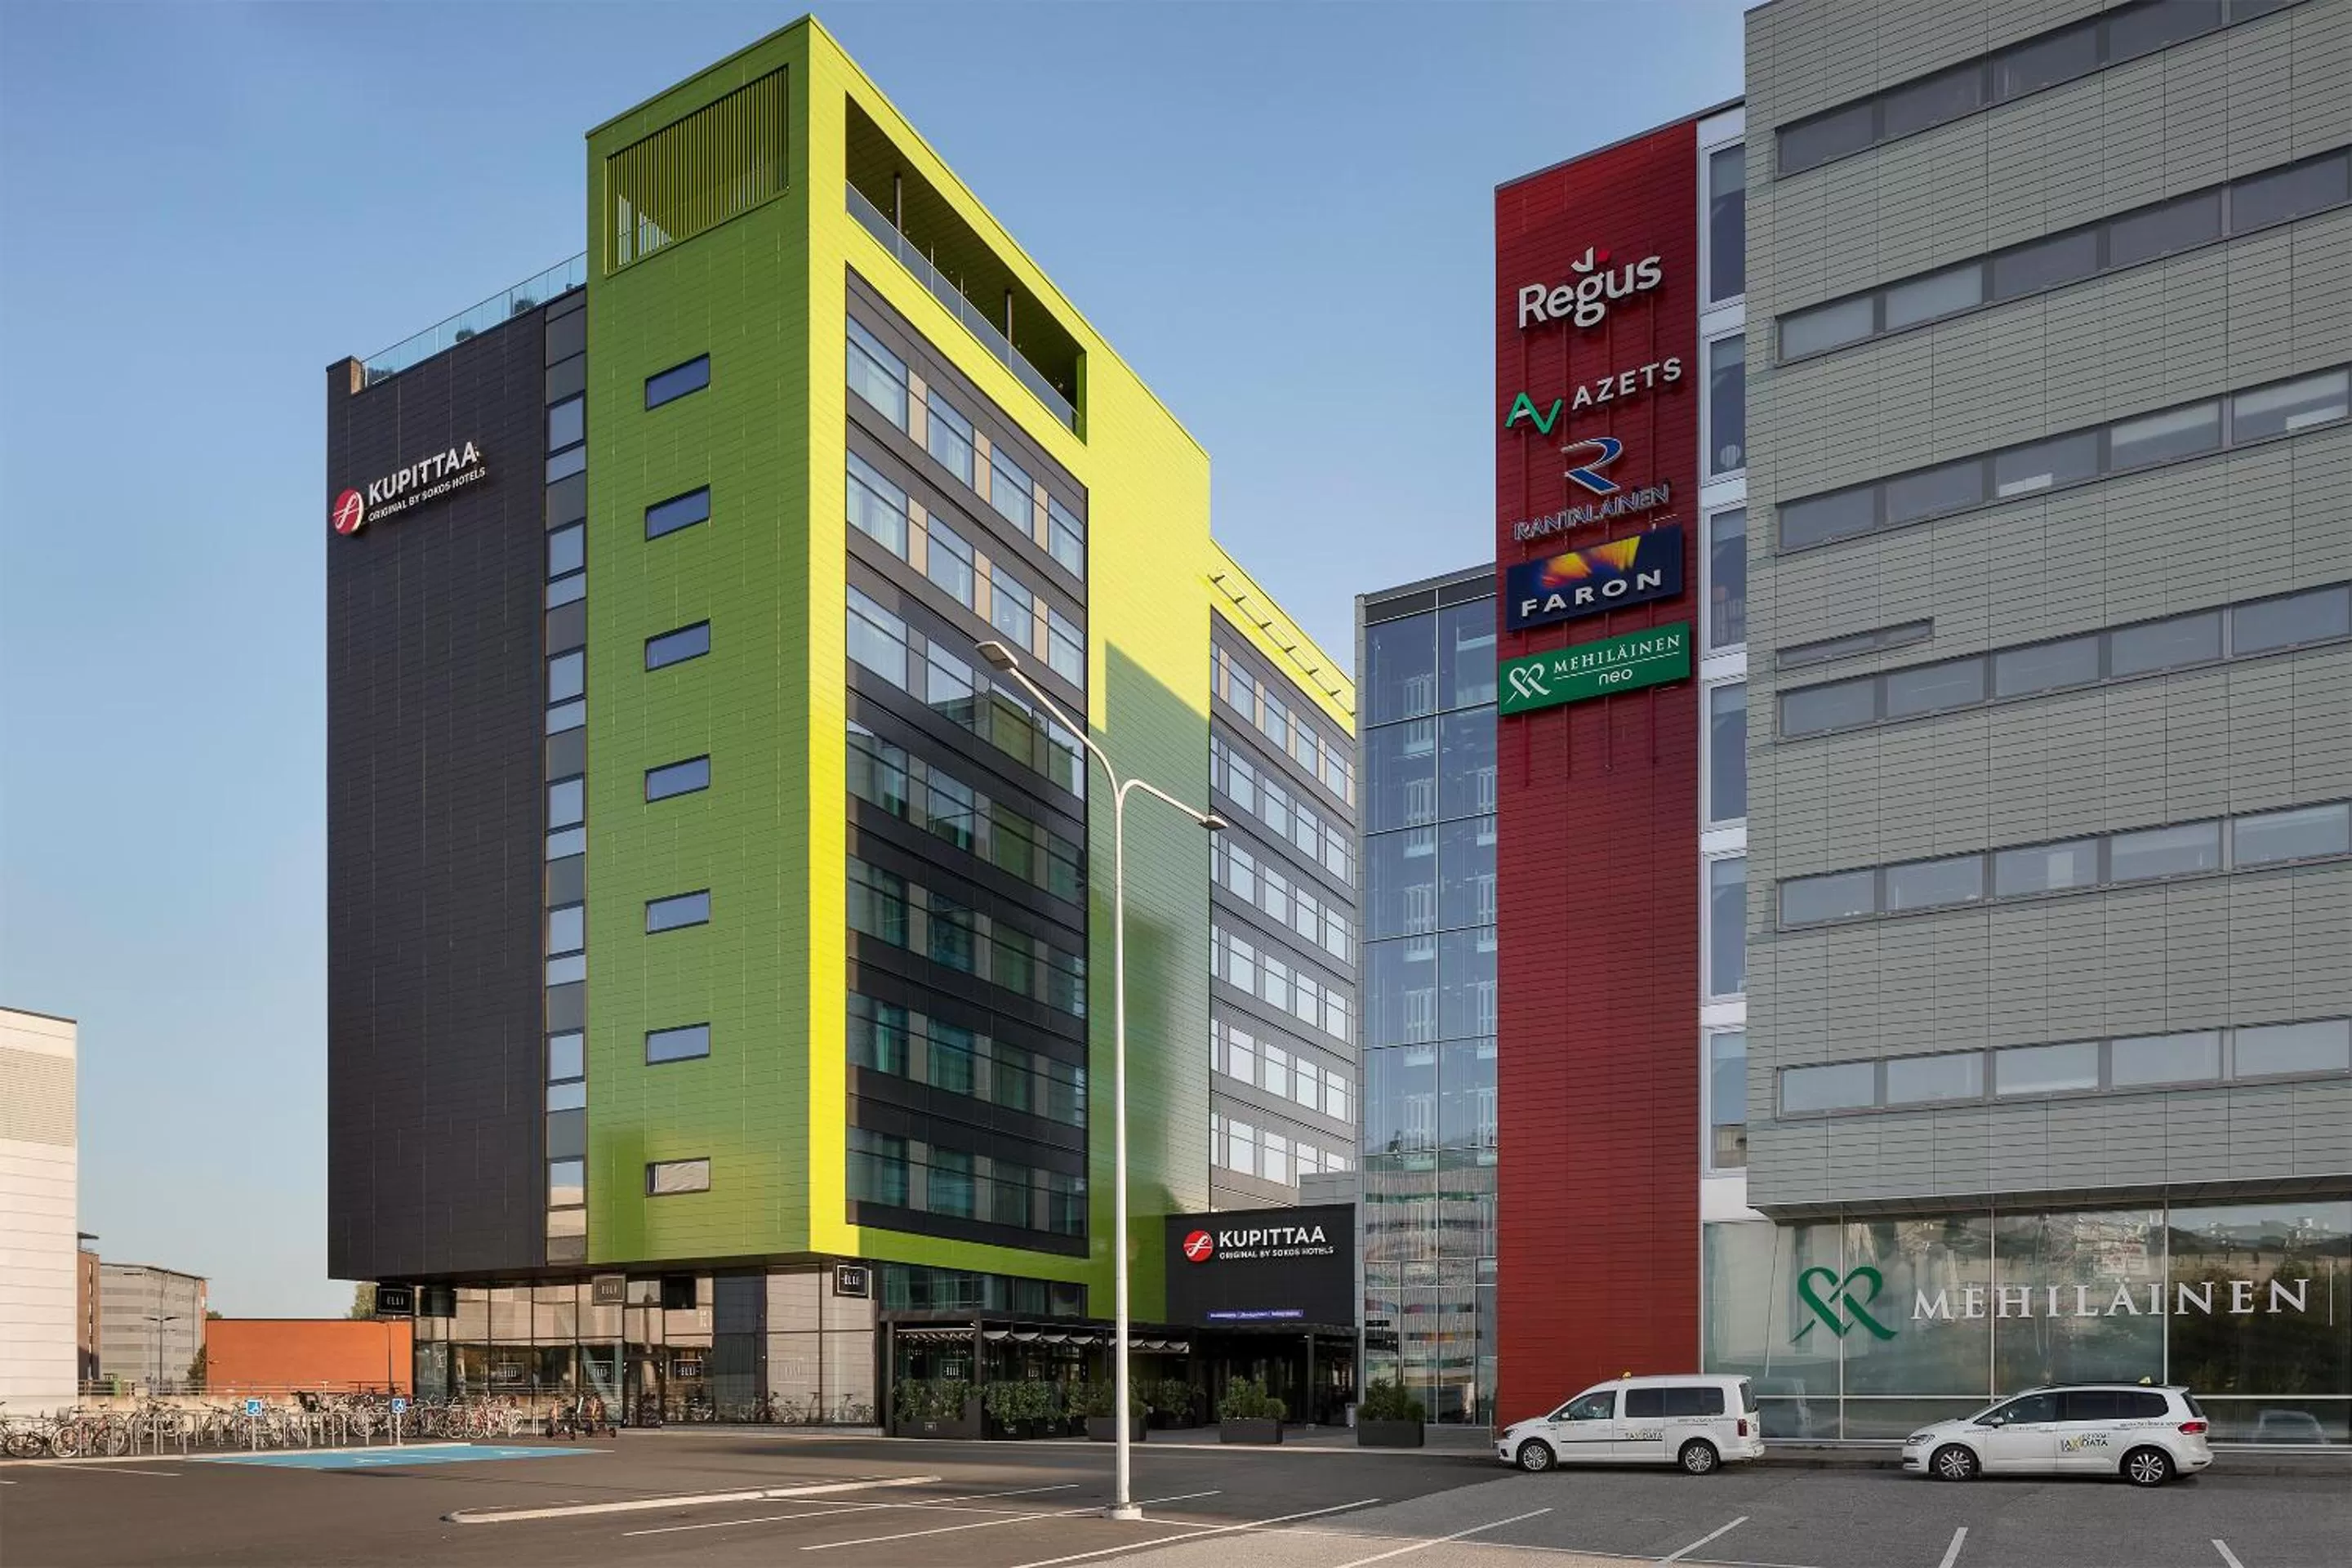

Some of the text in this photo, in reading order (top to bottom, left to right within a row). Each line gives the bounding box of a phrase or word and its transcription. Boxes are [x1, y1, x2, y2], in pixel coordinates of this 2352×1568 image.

[1518, 248, 1663, 329] Regus
[1572, 357, 1682, 410] AZETS
[368, 441, 478, 506] KUPITTAA
[368, 466, 486, 522] ORIGINAL BY SOKOS HOTELS
[1514, 483, 1670, 540] RANTALAINEN
[1521, 569, 1662, 617] FARON
[1553, 635, 1681, 674] MEHILÄINEN
[1598, 668, 1633, 686] neo
[1219, 1226, 1325, 1247] KUPITTAA
[1219, 1246, 1334, 1259] ORIGINAL BY SOKOS HOTELS
[1910, 1277, 2310, 1321] MEHILÄINEN
